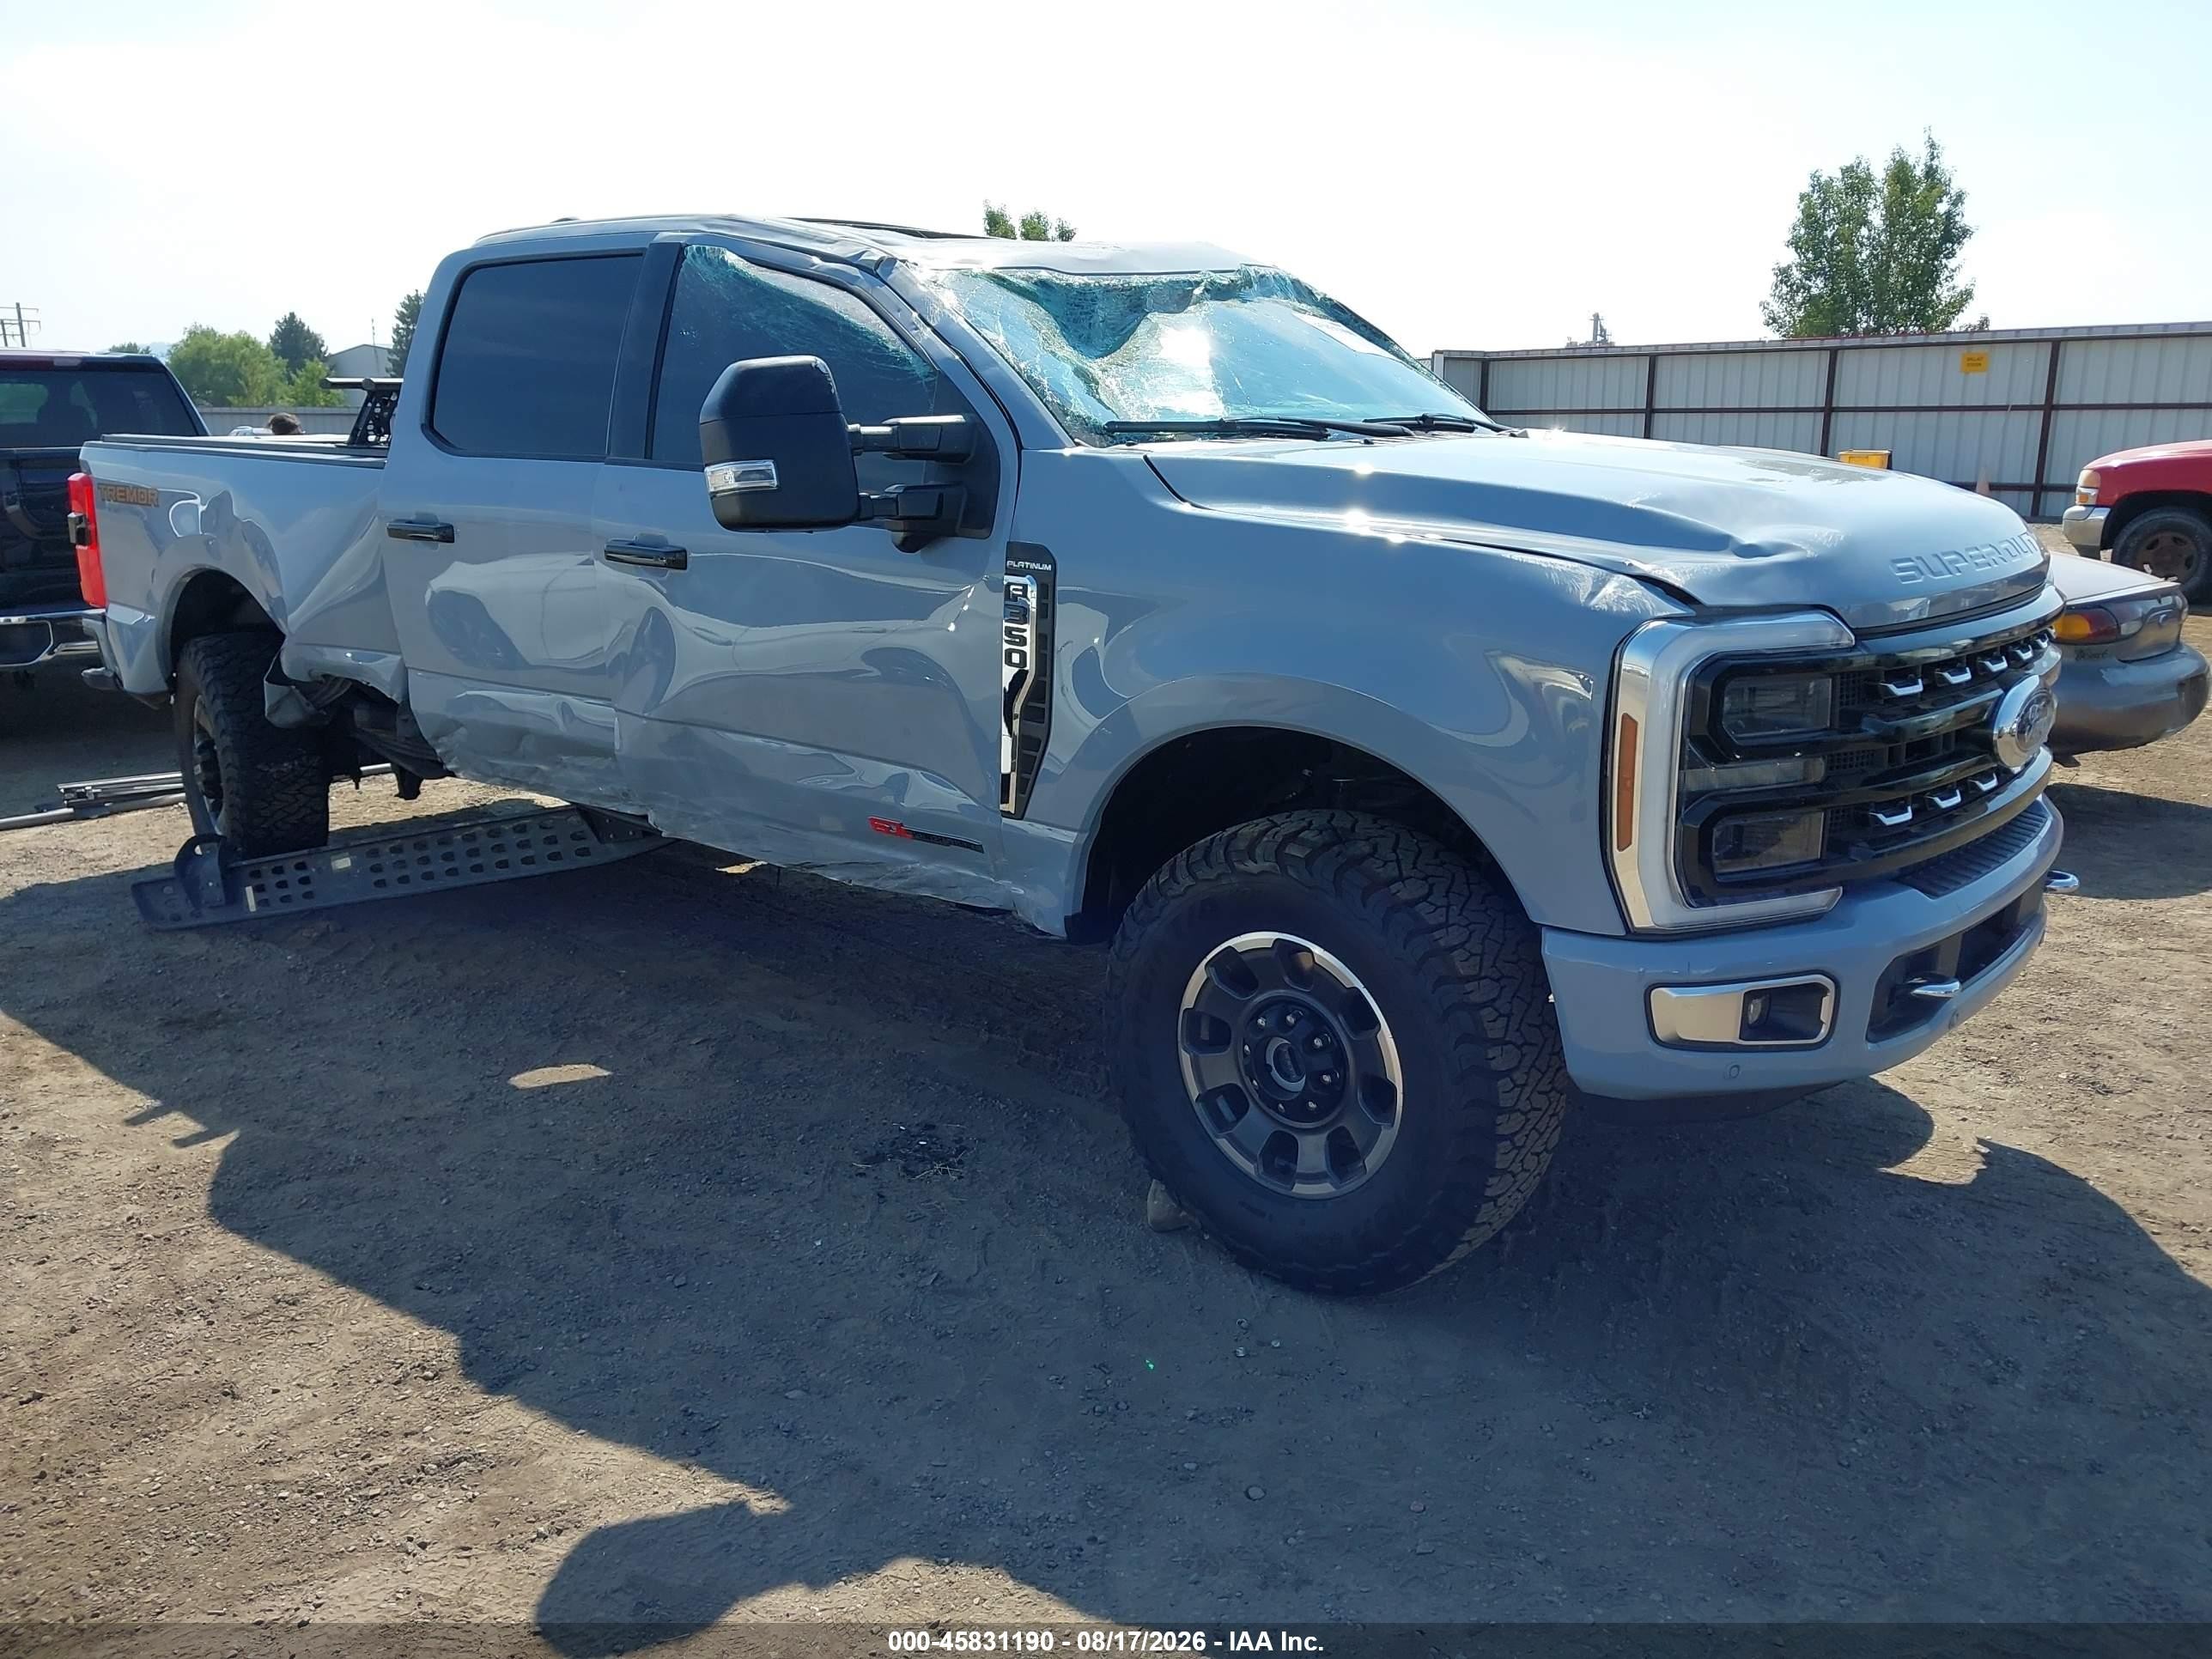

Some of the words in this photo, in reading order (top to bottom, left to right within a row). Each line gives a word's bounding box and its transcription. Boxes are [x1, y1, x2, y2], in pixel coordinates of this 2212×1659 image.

[97, 483, 160, 507] TREMOR
[1006, 560, 1052, 571] PLATINUM
[1889, 542, 2008, 585] SUPER
